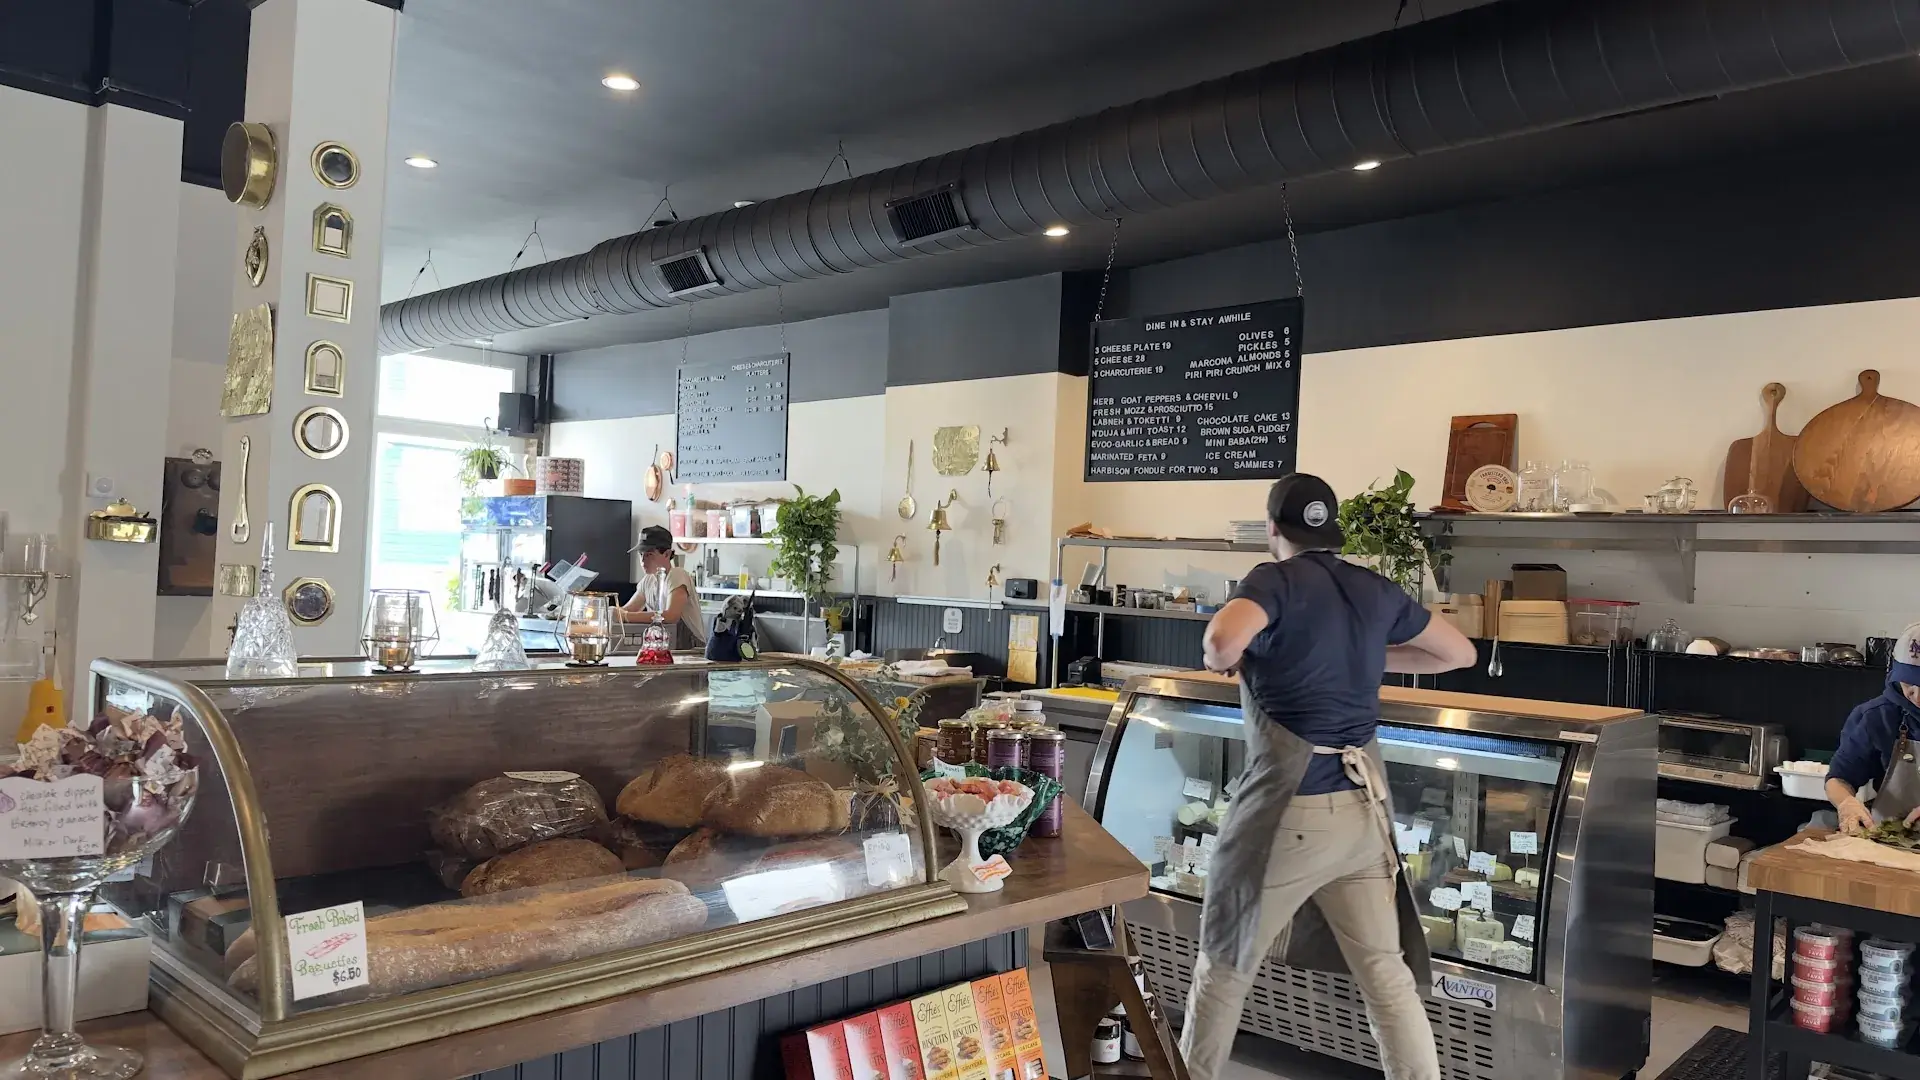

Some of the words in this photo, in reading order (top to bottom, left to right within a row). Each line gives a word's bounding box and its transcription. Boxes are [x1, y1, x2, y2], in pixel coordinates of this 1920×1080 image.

[1146, 322, 1166, 331] DINE
[1170, 320, 1179, 328] IN
[1190, 317, 1214, 326] STAY
[1218, 312, 1251, 324] AWHILE
[1239, 330, 1274, 341] OLIVES
[1284, 327, 1290, 335] 6
[1102, 344, 1132, 353] CHEESE
[1134, 343, 1160, 351] PLATE
[1162, 342, 1172, 350] 19
[1238, 341, 1278, 352] PICKLES
[1284, 338, 1290, 346] 5
[1094, 358, 1099, 366] 5
[1101, 356, 1133, 365] CHEESE
[1135, 355, 1146, 363] 28
[1190, 357, 1233, 369] MARCONA
[1238, 351, 1281, 363] ALMONDS
[1284, 350, 1290, 358] 5
[1100, 367, 1153, 377] CHARCUTERIE
[1185, 371, 1202, 379] PIRI
[1206, 369, 1223, 378] PIRI
[1225, 364, 1260, 375] CRUNCH
[1266, 361, 1283, 370] MIX
[1285, 360, 1290, 369] 6
[1093, 398, 1114, 406] HERB
[1121, 396, 1142, 405] GOAT
[1145, 394, 1181, 403] PEPPERS
[1186, 393, 1191, 401] &
[1193, 393, 1230, 401] CHERVIL
[1233, 391, 1238, 399] 9
[1093, 408, 1121, 417] FRESH
[1125, 407, 1146, 415] MOZZ
[1154, 404, 1203, 413] PROSCIUTTO
[1205, 403, 1214, 411] 15
[1093, 418, 1124, 426] LABNEH
[1134, 416, 1170, 425] TOKETTI
[1176, 415, 1181, 423] 9
[1197, 415, 1249, 425] CHOCOLATE
[1254, 413, 1278, 422] CAKE
[1282, 412, 1291, 421] 13
[1127, 427, 1143, 436] MITI
[1147, 426, 1174, 435] TOAST
[1201, 427, 1231, 436] BROWN
[1232, 425, 1255, 435] SUGA
[1152, 438, 1180, 447] BREAD
[1206, 439, 1225, 447] MINI
[1278, 436, 1287, 444] 15
[1091, 453, 1134, 461] MARINATED
[1206, 452, 1221, 460] ICE
[1224, 450, 1256, 459] CREAM
[1091, 467, 1130, 475] HARBISON
[1134, 467, 1166, 475] FONDUE
[1169, 466, 1185, 474] FOR
[1188, 466, 1207, 474] TWO
[1210, 467, 1219, 475] 18
[1234, 461, 1274, 469] SAMMIES
[289, 916, 326, 935] Fresh
[325, 907, 360, 928] Baked
[294, 955, 358, 977] Baguettes
[333, 967, 362, 986] $6.50
[1435, 976, 1494, 1002] AVANTCO
[1010, 1006, 1034, 1020] BISCUITS
[952, 1022, 979, 1040] BISCUITS
[922, 1033, 949, 1049] BISCUITS
